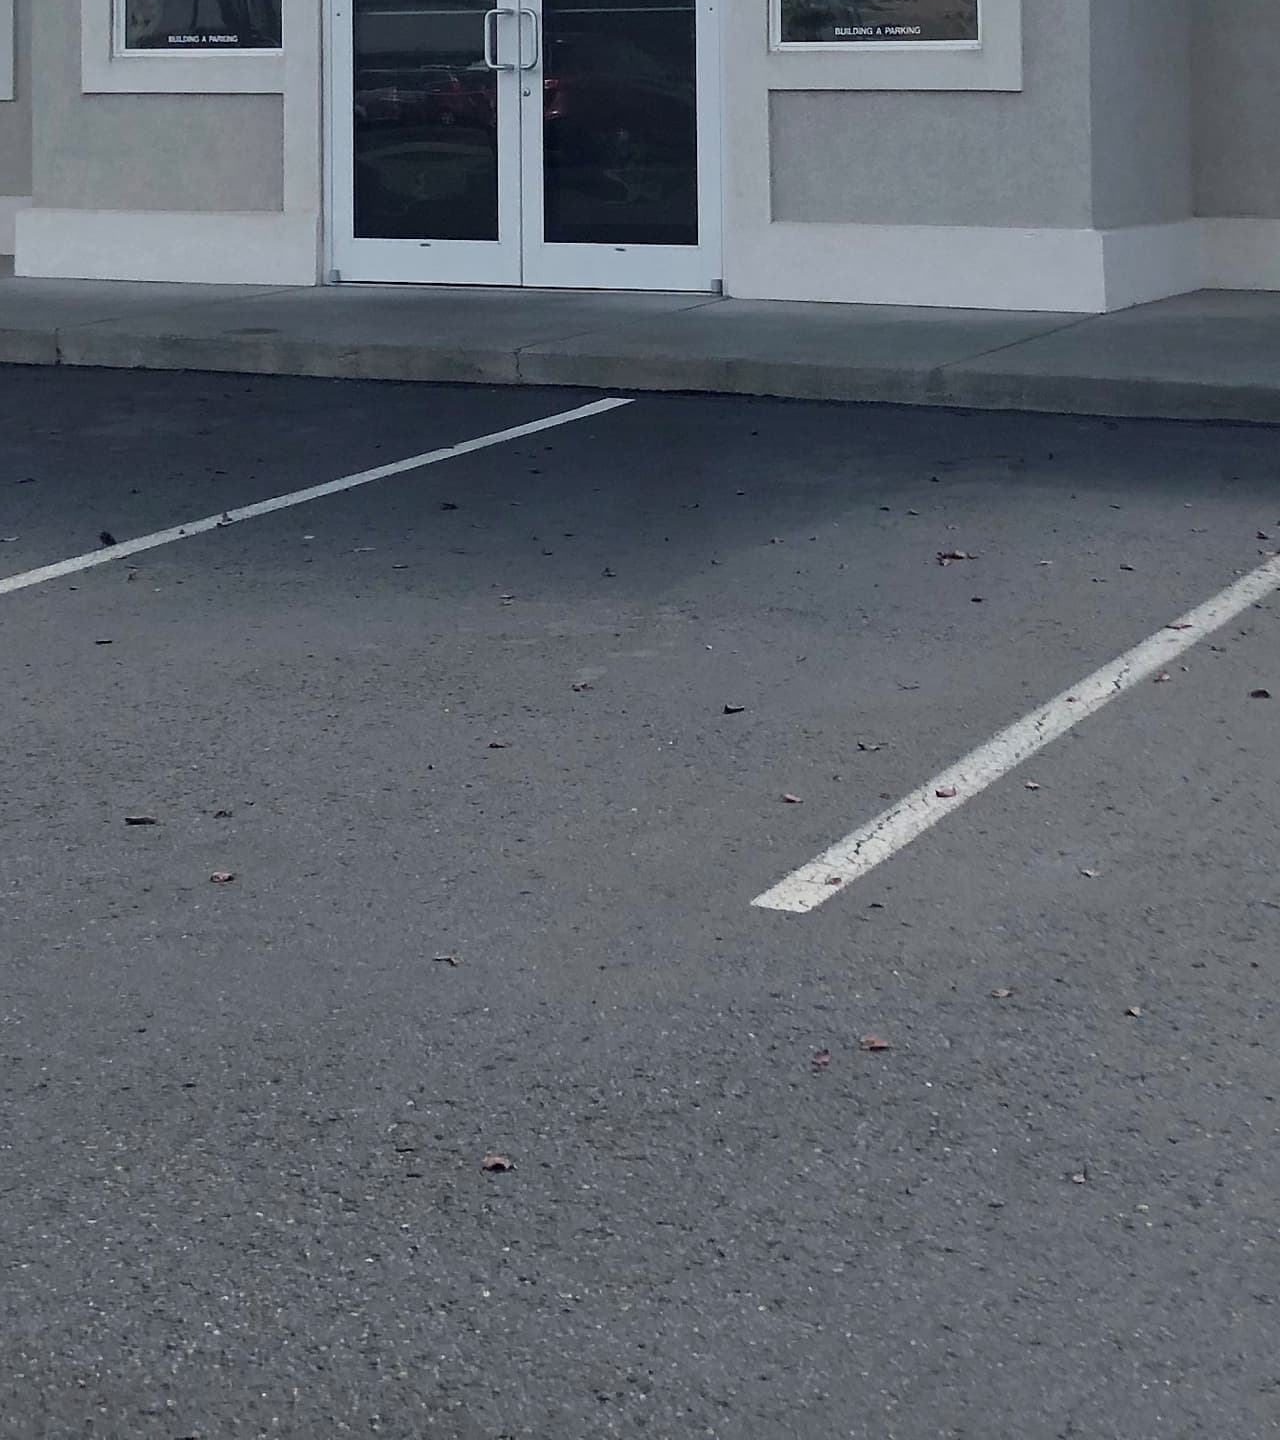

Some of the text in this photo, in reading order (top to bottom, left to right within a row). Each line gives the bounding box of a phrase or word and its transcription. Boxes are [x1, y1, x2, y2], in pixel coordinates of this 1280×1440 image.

[835, 26, 921, 35] BUILDING A PARKING
